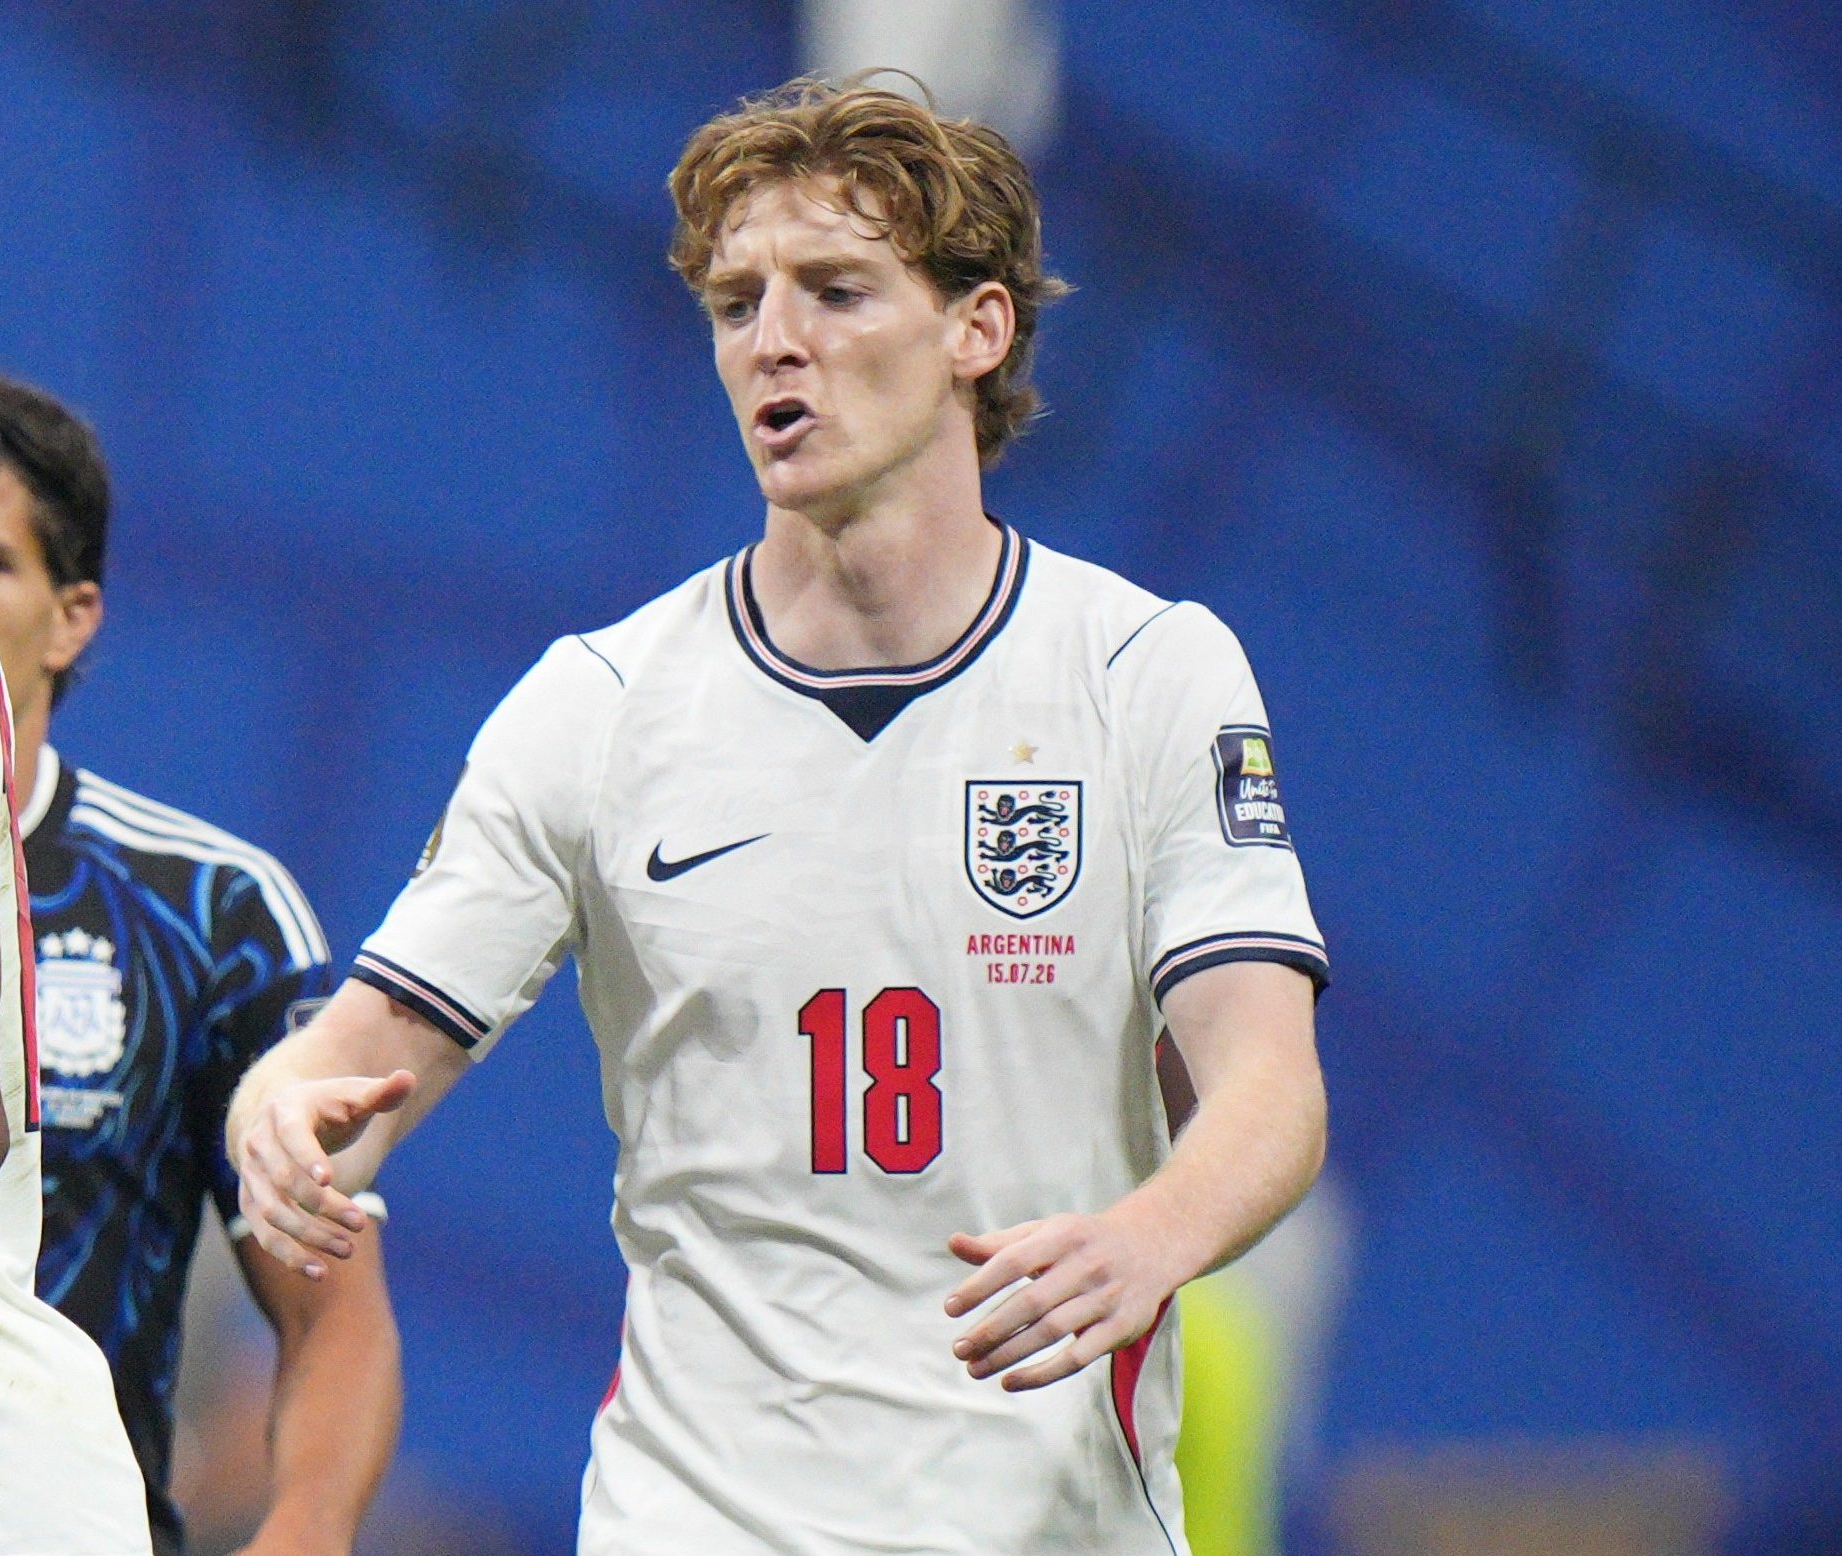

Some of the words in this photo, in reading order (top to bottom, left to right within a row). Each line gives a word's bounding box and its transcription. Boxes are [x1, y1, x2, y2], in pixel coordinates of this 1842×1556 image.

[967, 934, 1075, 956] ARGENTINA
[987, 963, 1055, 985] 15.07.26
[797, 987, 943, 1176] 18
